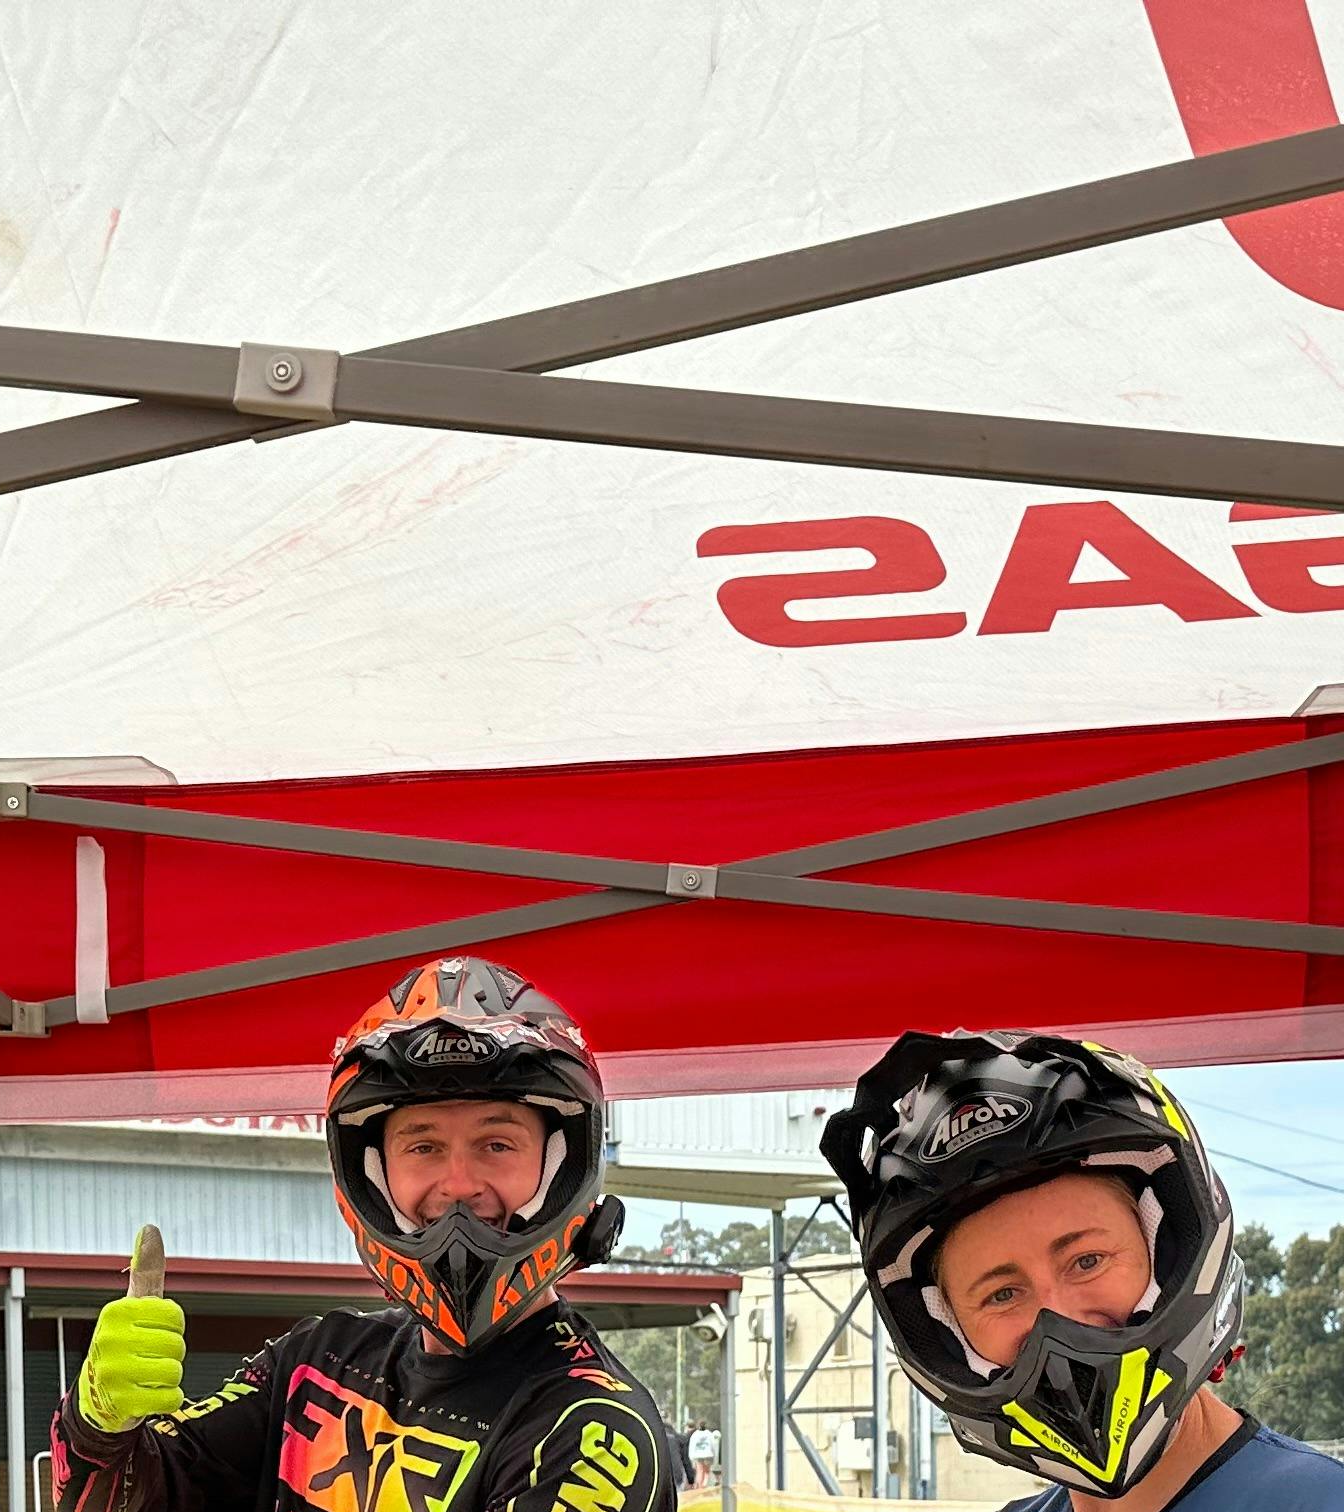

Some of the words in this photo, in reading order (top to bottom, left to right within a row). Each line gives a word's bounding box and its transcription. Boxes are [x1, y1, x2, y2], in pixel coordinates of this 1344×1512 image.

[414, 1031, 489, 1058] Airoh
[928, 1096, 1019, 1156] Airoh
[492, 1202, 594, 1324] AIRO
[1040, 1428, 1080, 1459] AIROH
[1112, 1396, 1131, 1444] AIROH
